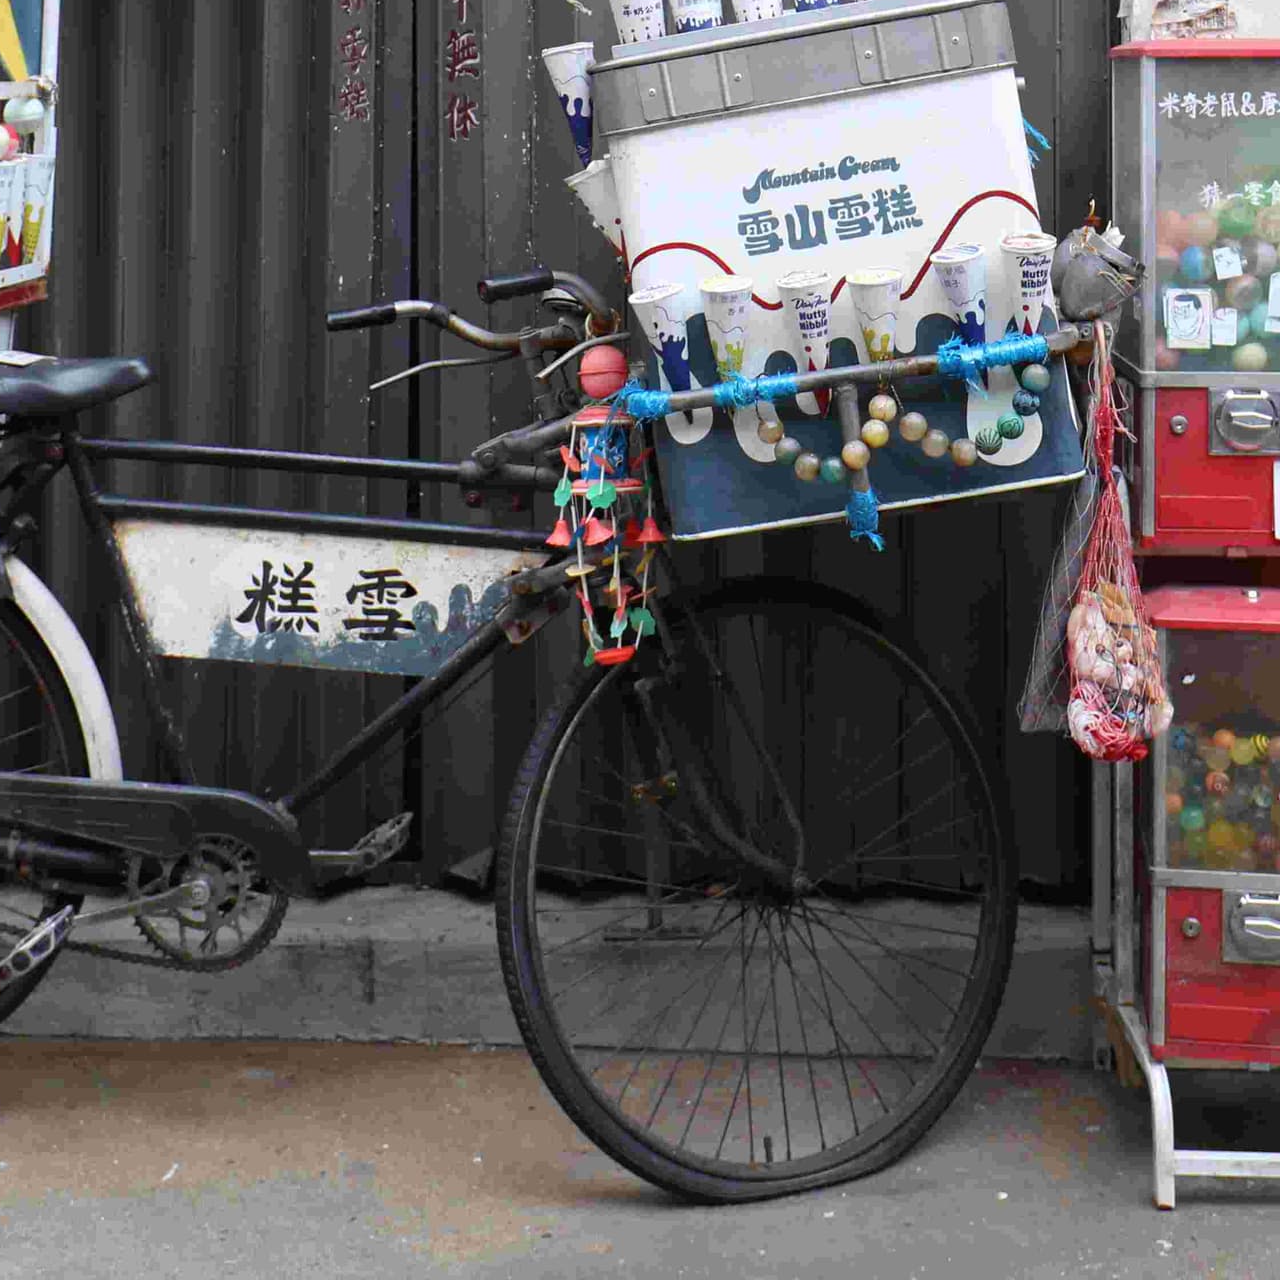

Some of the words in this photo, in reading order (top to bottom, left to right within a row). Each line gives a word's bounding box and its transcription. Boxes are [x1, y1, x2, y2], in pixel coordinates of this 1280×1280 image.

[742, 161, 837, 204] Mountain
[838, 155, 901, 181] Cream
[737, 184, 924, 257] 雪山雪糕
[798, 309, 827, 321] Nutty
[235, 560, 418, 641] 雪糕
